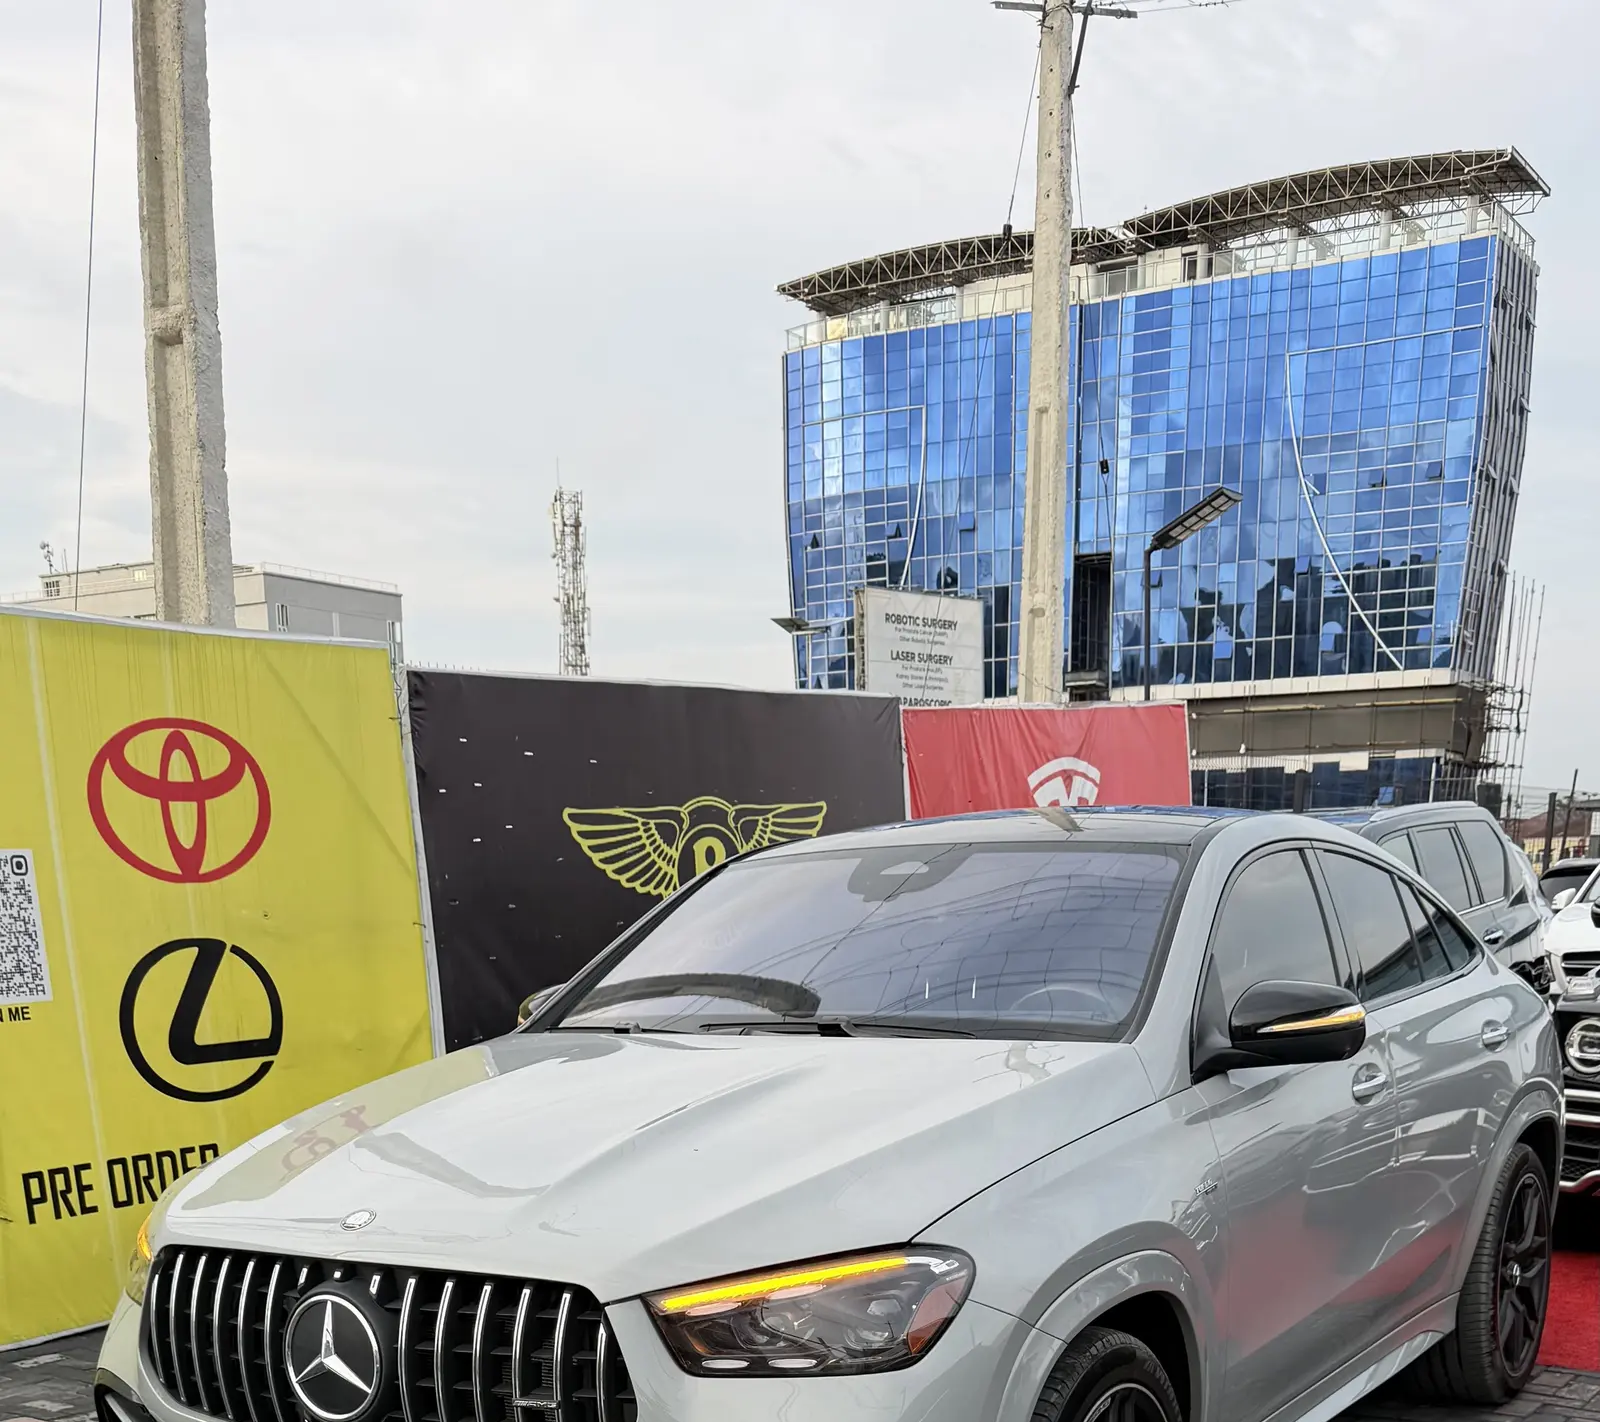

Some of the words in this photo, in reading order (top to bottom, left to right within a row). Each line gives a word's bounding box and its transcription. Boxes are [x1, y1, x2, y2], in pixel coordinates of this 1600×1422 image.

[885, 613, 920, 626] ROBOTIC
[922, 617, 958, 631] SURGERY
[890, 650, 916, 662] LASER
[917, 652, 953, 666] SURGERY
[8, 1006, 32, 1022] ME
[21, 1162, 99, 1225] PRE
